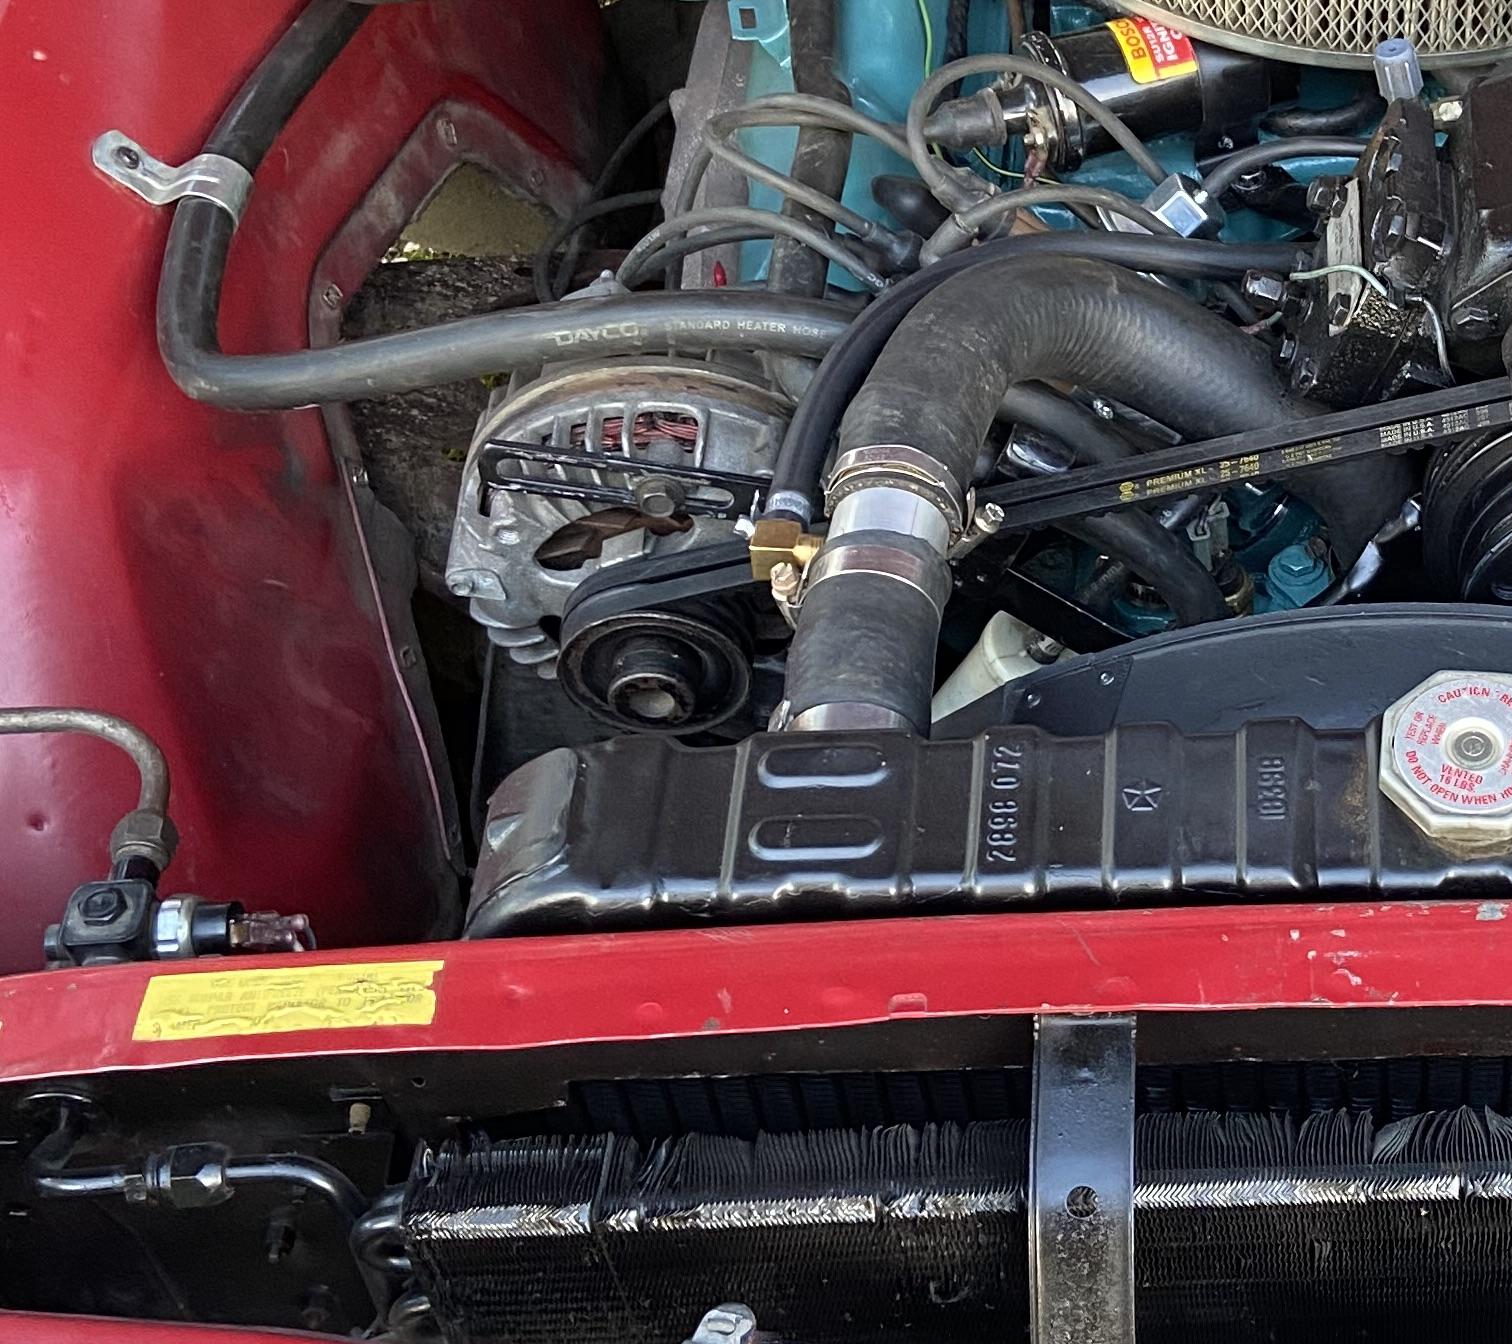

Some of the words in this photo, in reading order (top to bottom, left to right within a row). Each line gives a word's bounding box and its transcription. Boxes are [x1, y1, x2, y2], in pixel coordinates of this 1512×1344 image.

[663, 320, 731, 333] STANDARD
[737, 320, 786, 334] HEATER
[792, 325, 826, 339] HOSE
[1146, 470, 1193, 487] PREMIUM
[1405, 750, 1418, 765] DO
[1410, 765, 1432, 785] NOT
[1430, 783, 1459, 803] OPEN
[1461, 793, 1497, 805] WHEN
